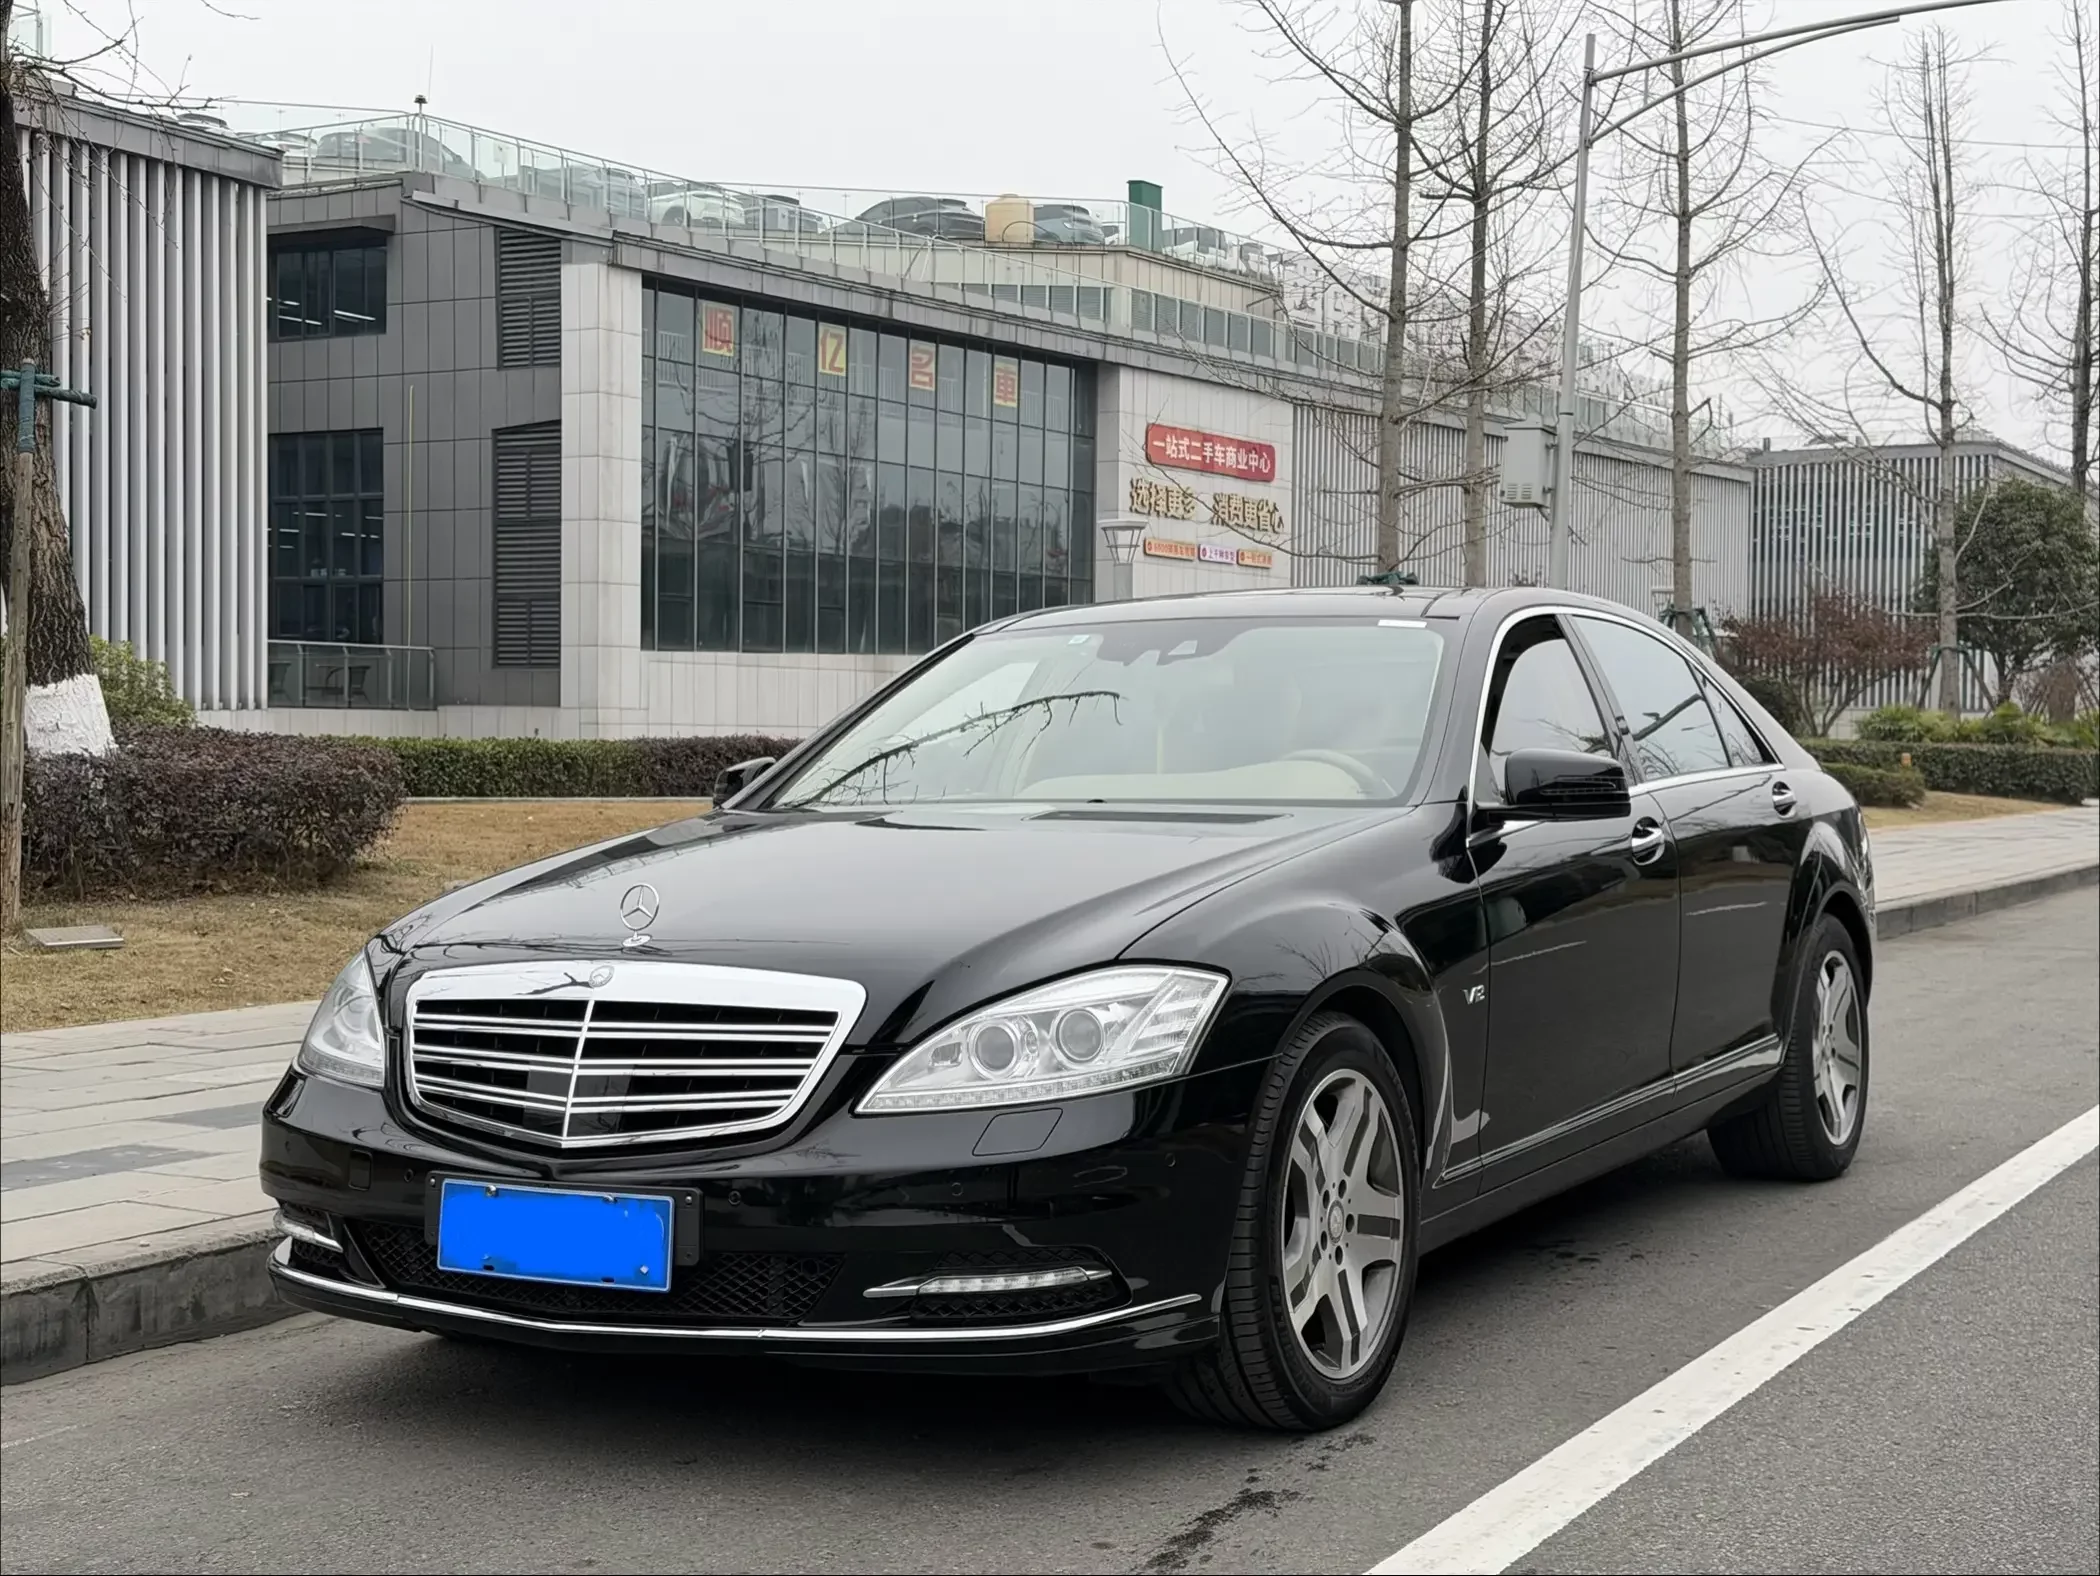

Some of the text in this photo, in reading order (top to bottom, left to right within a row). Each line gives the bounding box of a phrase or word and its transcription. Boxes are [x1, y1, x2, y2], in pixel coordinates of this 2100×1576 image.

[704, 305, 733, 354] 顺
[820, 328, 844, 373] 亿
[911, 345, 934, 387] 名
[1152, 434, 1271, 474] 一站式二手车商业中心
[1130, 478, 1284, 534] 选择更多 消费更省心
